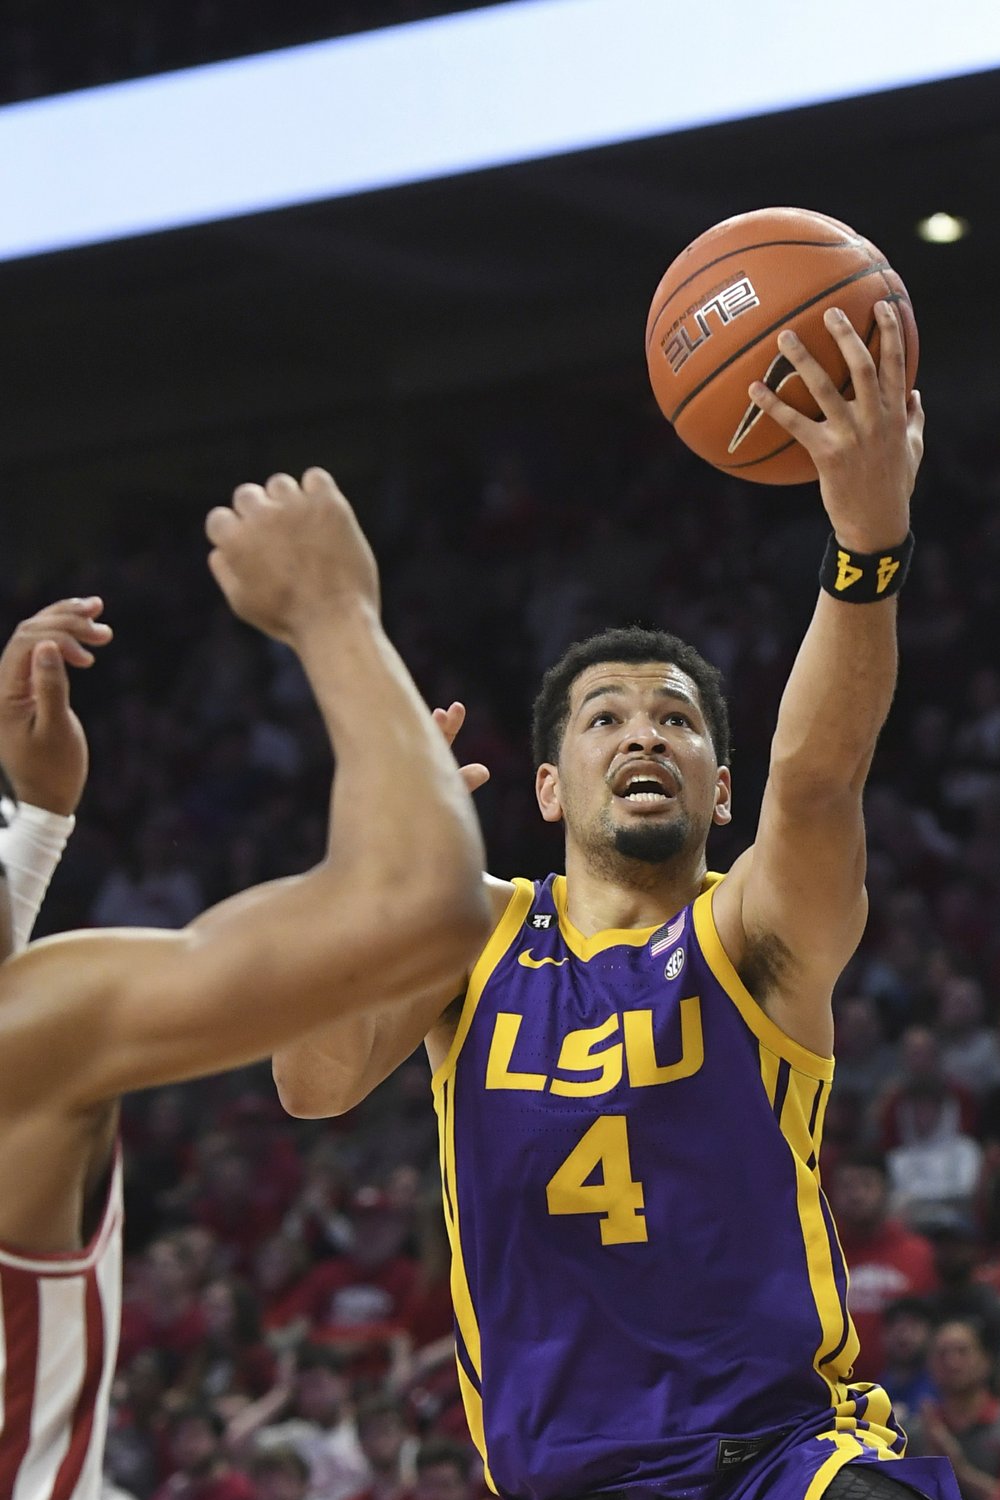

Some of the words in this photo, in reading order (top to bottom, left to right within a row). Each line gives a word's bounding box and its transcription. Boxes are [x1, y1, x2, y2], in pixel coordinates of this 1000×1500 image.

[663, 277, 761, 376] ELITE
[665, 949, 683, 977] SEC
[485, 996, 704, 1098] LSU
[546, 1115, 648, 1246] 4
